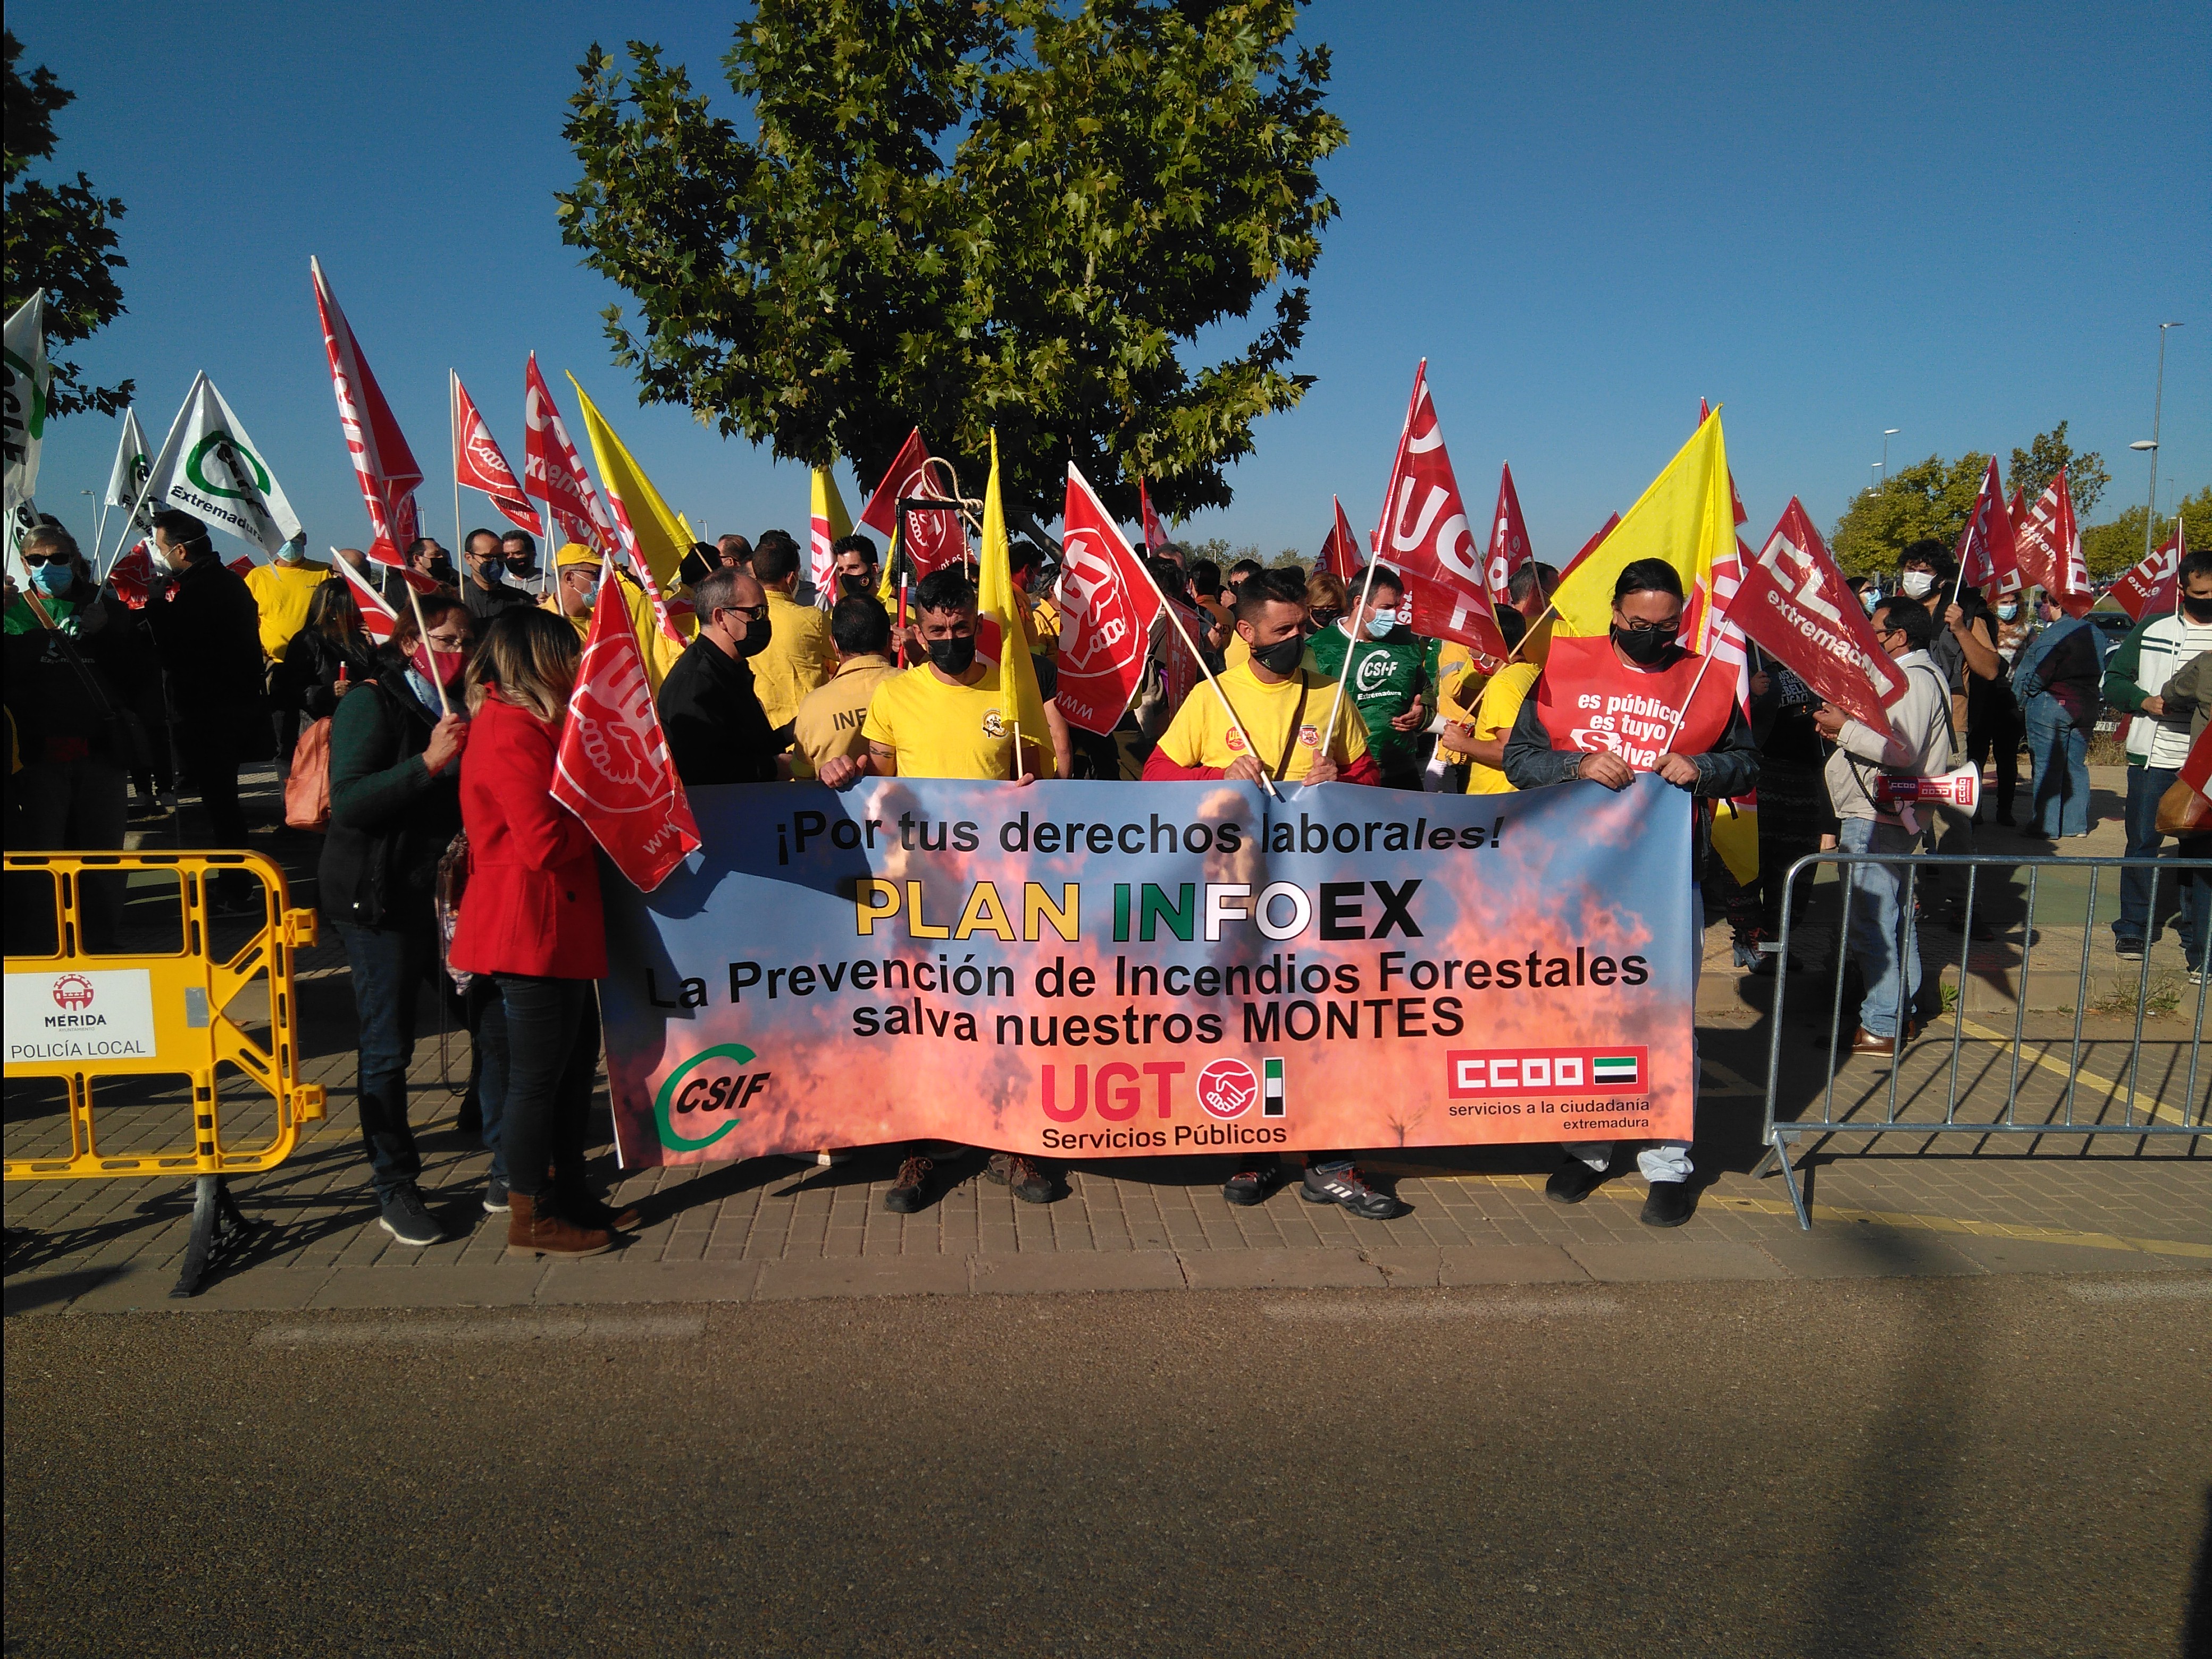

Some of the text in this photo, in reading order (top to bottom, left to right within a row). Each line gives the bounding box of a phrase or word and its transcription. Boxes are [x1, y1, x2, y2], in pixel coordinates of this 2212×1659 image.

[170, 484, 264, 544] Extremadura
[1357, 690, 1402, 701] Extremadura
[1578, 693, 1685, 730] es público,
[1589, 714, 1666, 740] es tuyo
[776, 810, 1505, 865] ¡Por tus derechos laborales!
[854, 878, 1423, 942] PLAN INFOEX
[646, 946, 1649, 1009] La Prevención de Incendios Forestales
[45, 1014, 107, 1027] MÉRIDA
[852, 996, 1464, 1046] salva nuestros MONTES
[11, 1040, 146, 1059] POLICÍA LOCAL
[1457, 1057, 1583, 1088] CCOO
[675, 1071, 771, 1113] CSIF
[1042, 1061, 1185, 1122] UGT
[1449, 1099, 1649, 1116] servicios a la ciudadanía
[1043, 1124, 1287, 1149] Servicios Públicos
[1563, 1117, 1649, 1130] extremadura
